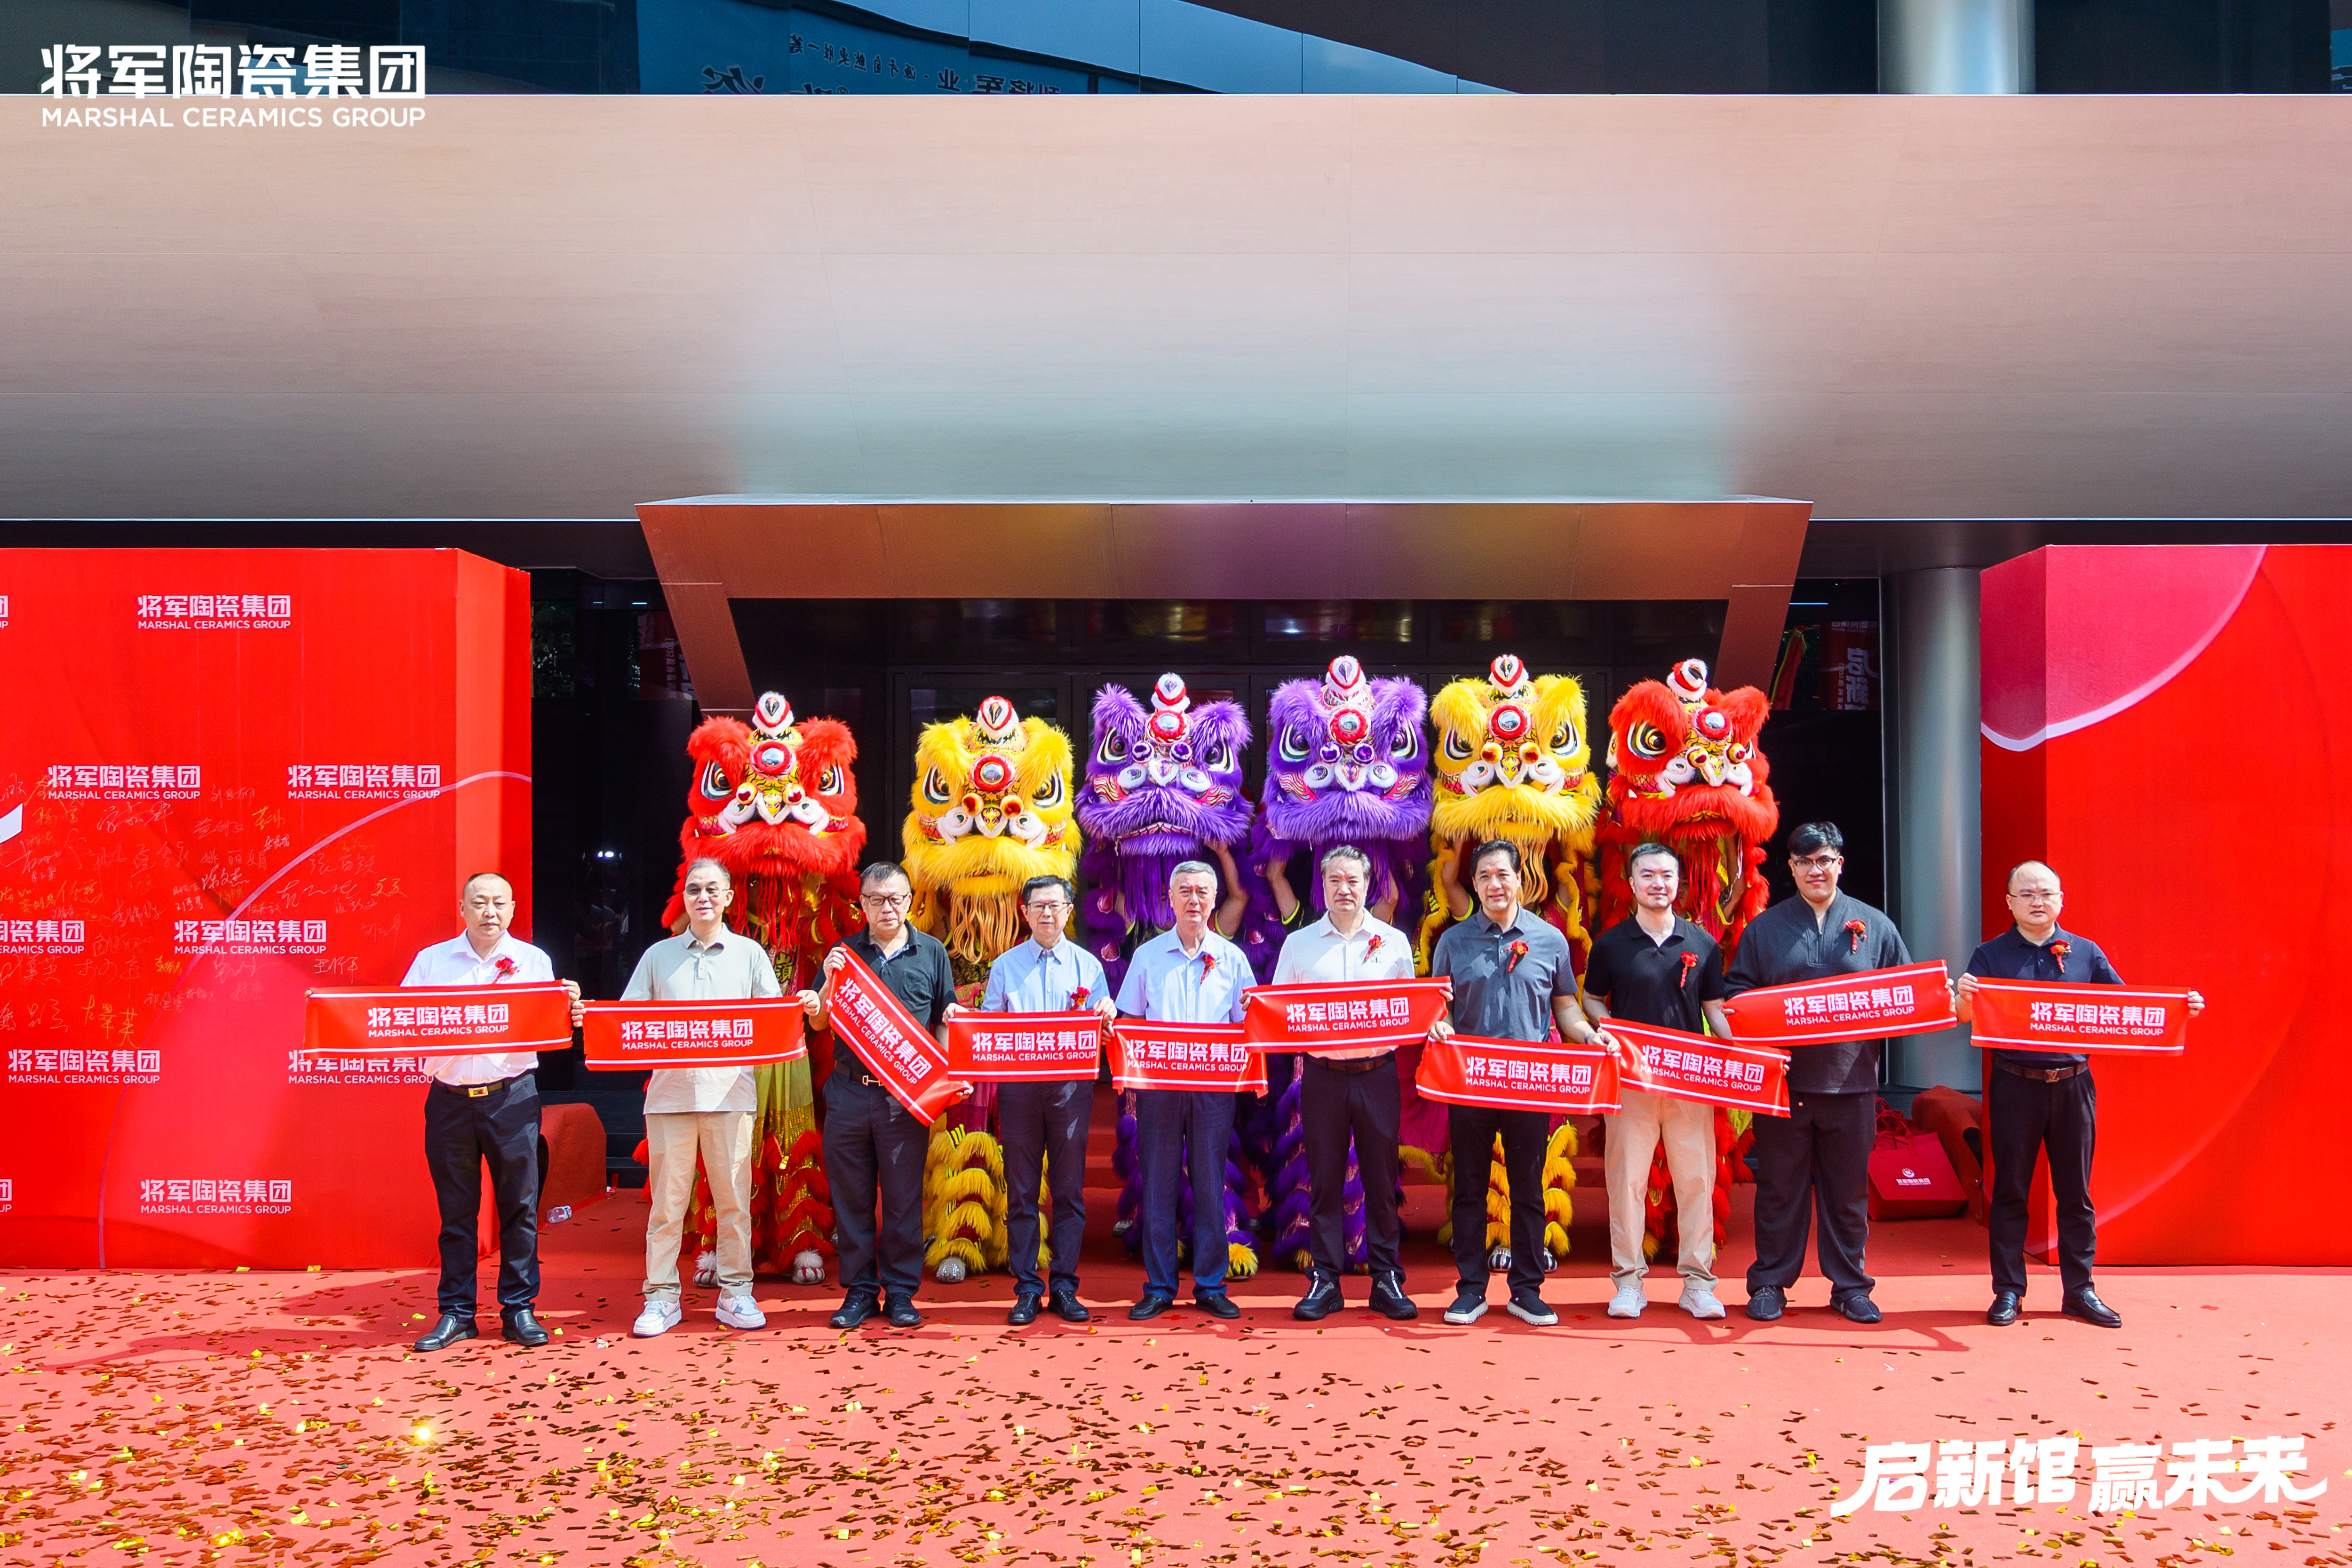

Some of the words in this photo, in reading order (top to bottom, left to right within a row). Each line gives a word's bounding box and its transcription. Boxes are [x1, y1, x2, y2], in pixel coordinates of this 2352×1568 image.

[138, 595, 290, 617] 将军陶瓷集团
[46, 765, 200, 788] 将军陶瓷集团
[288, 765, 440, 787] 将军陶瓷集团
[404, 791, 441, 799] GROUP
[175, 920, 326, 943] 将军陶瓷集团
[1286, 997, 1409, 1023] 将军陶瓷集团
[1784, 986, 1914, 1016] 将军陶瓷集团
[368, 1004, 509, 1027] 将军陶瓷集团
[1333, 1020, 1377, 1030] CERAMICS
[1380, 1018, 1409, 1027] GROUP
[1787, 1016, 1830, 1025] MARSHAL
[1833, 1010, 1880, 1021] CERAMICS
[1883, 1006, 1915, 1016] GROUP
[2031, 1002, 2165, 1026] 将军陶瓷集团
[421, 1027, 472, 1035] CERAMICS
[475, 1025, 509, 1034] GROUP
[622, 1019, 753, 1040] 将军陶瓷集团
[834, 992, 860, 1027] MARSHAL
[861, 1025, 895, 1062] CERAMICS
[893, 1062, 918, 1084] GROUP
[839, 977, 933, 1080] 将军陶瓷集团
[2031, 1023, 2076, 1032] MARSHAL
[2079, 1026, 2128, 1035] CERAMICS
[972, 1030, 1097, 1051] 将军陶瓷集团
[1126, 1039, 1248, 1063] 将军陶瓷集团
[9, 1050, 159, 1072] 将军陶瓷集团
[288, 1050, 427, 1072] 将军陶瓷集
[1067, 1051, 1097, 1060] GROUP
[1127, 1059, 1168, 1070] MARSHAL
[1219, 1064, 1247, 1072] GROUP
[1641, 1045, 1764, 1084] 将军陶瓷集团
[1465, 1057, 1592, 1085] 将军陶瓷集团
[1640, 1065, 1680, 1079] MARSHAL
[1684, 1074, 1728, 1087] CERAMICS
[1732, 1082, 1761, 1091] GROUP
[1466, 1078, 1508, 1088] MARSHAL
[1511, 1082, 1556, 1091] CERAMICS
[1559, 1085, 1591, 1094] GROUP
[141, 1179, 291, 1202] 将军陶瓷集团
